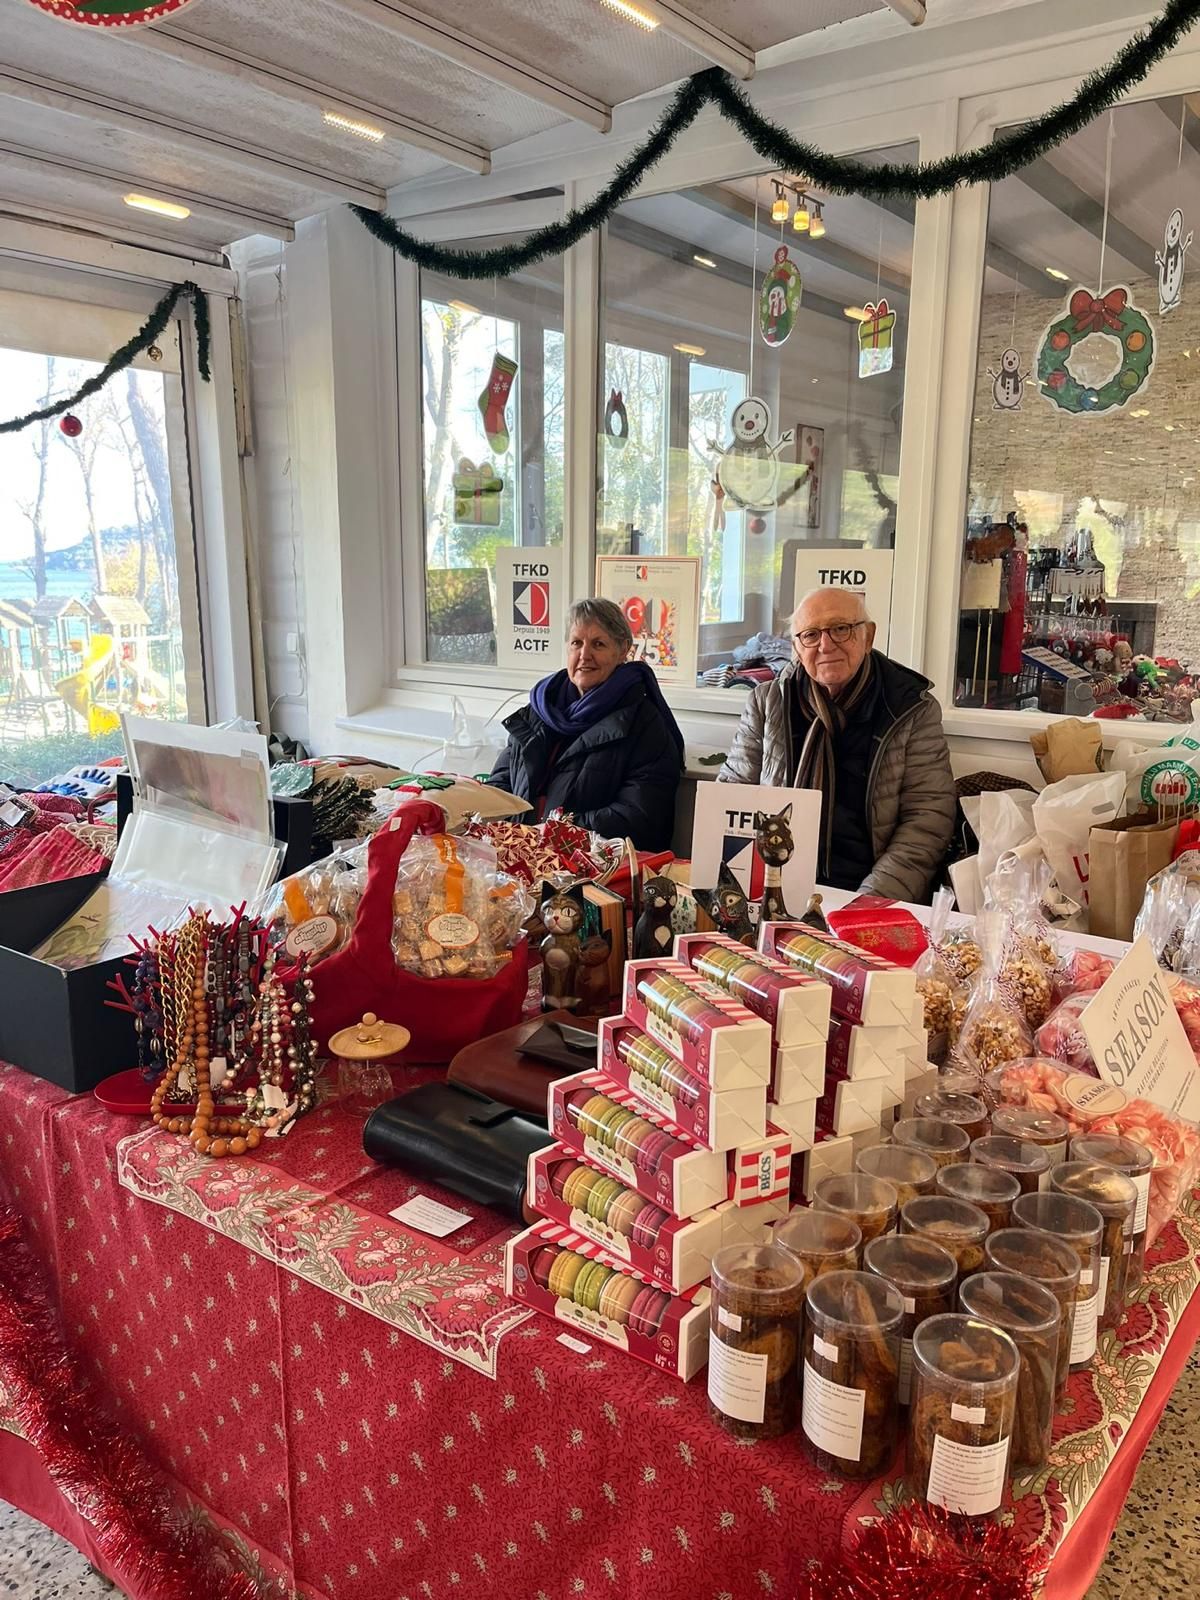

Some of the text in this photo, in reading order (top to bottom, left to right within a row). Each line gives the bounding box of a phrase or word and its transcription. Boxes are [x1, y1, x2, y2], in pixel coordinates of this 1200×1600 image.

[513, 564, 549, 577] TFKD
[818, 569, 867, 586] TFKD
[513, 626, 535, 635] Depuis
[514, 638, 549, 652] ACTF
[633, 638, 661, 664] 75
[725, 810, 777, 831] TF
[1104, 972, 1169, 1087] SEASON
[1076, 1082, 1111, 1108] SEASON
